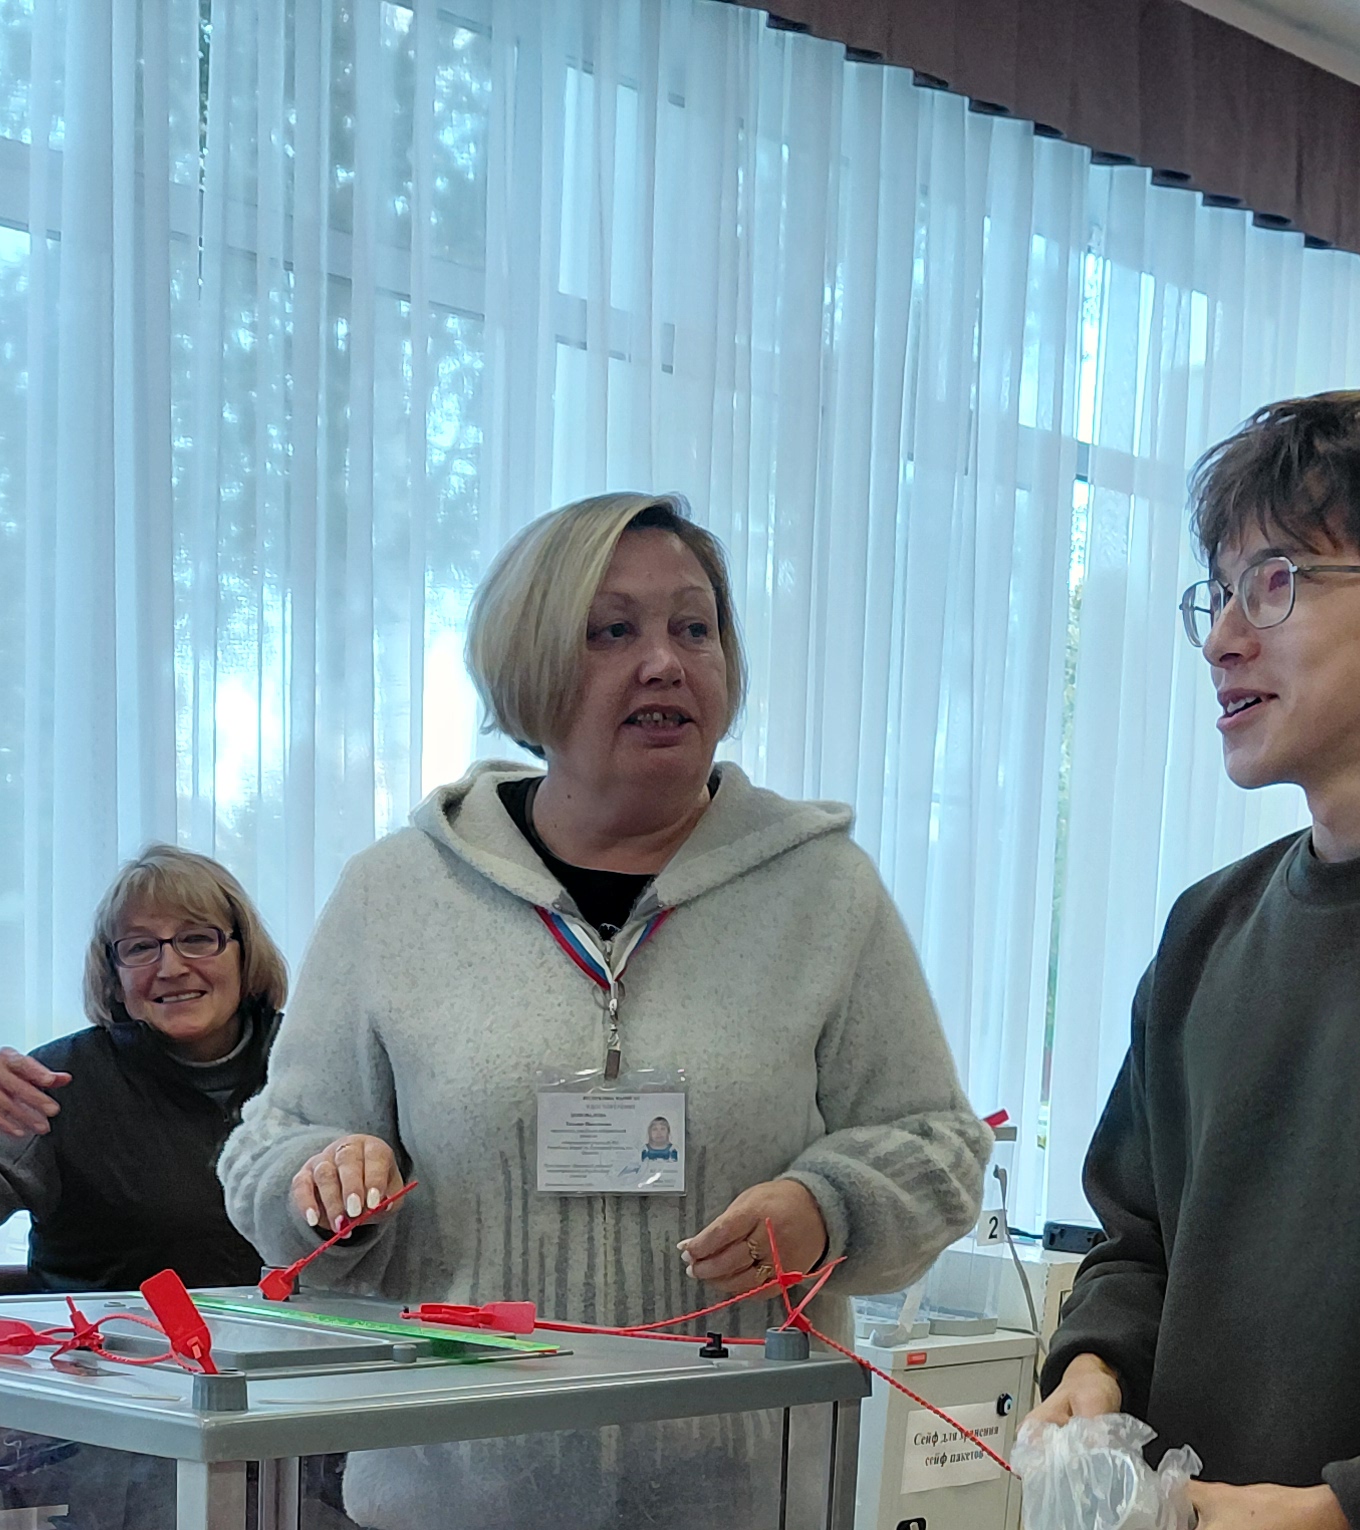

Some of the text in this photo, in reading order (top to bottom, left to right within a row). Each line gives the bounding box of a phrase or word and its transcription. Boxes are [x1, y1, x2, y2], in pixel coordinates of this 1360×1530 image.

[988, 1216, 999, 1240] 2
[914, 1431, 939, 1447] Сейф
[941, 1431, 958, 1444] для
[925, 1450, 984, 1467] сейф пакетов
